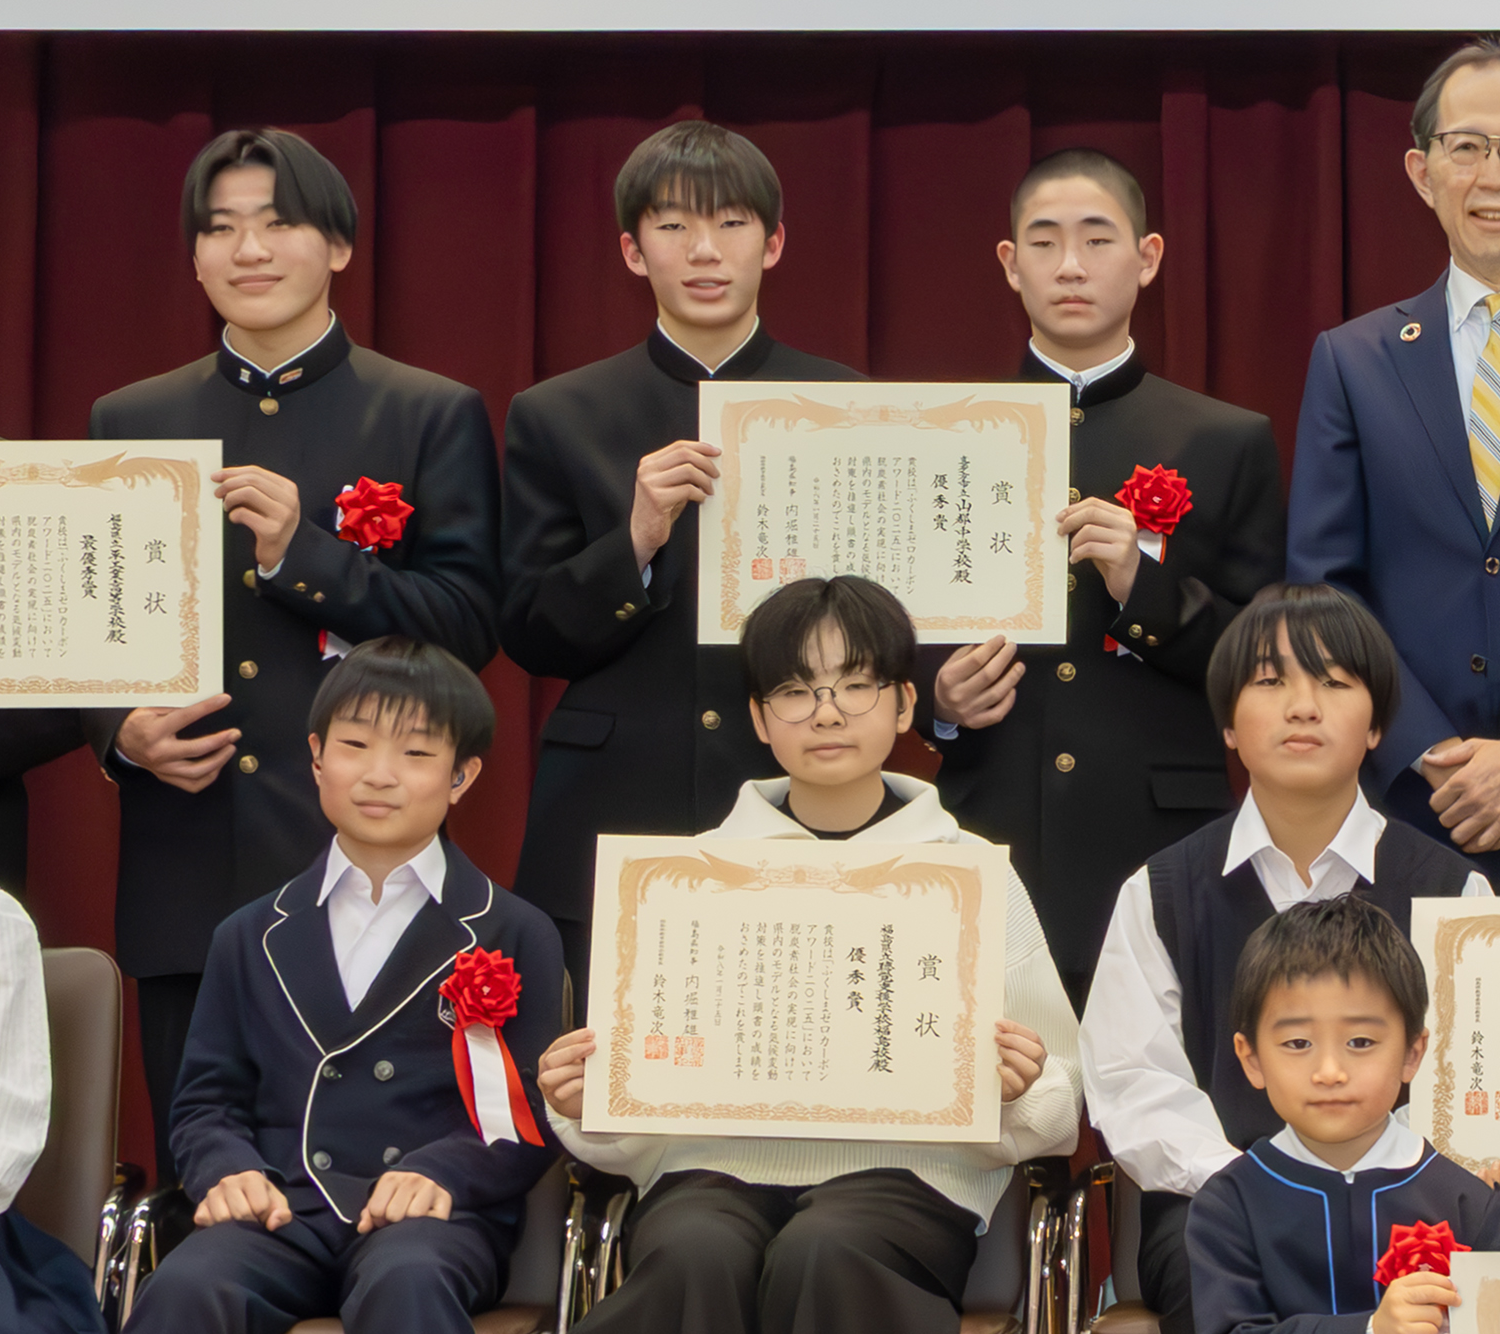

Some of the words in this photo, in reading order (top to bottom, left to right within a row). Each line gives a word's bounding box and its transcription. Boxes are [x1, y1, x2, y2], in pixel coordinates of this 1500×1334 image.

[930, 473, 949, 532] 優秀賞
[989, 480, 1014, 554] 賞状
[79, 533, 98, 600] 最優秀賞
[143, 538, 167, 615] 賞状
[845, 946, 867, 1013] 優秀賞
[914, 953, 942, 1038] 賞状
[1469, 1030, 1485, 1092] 鈴木竜次
